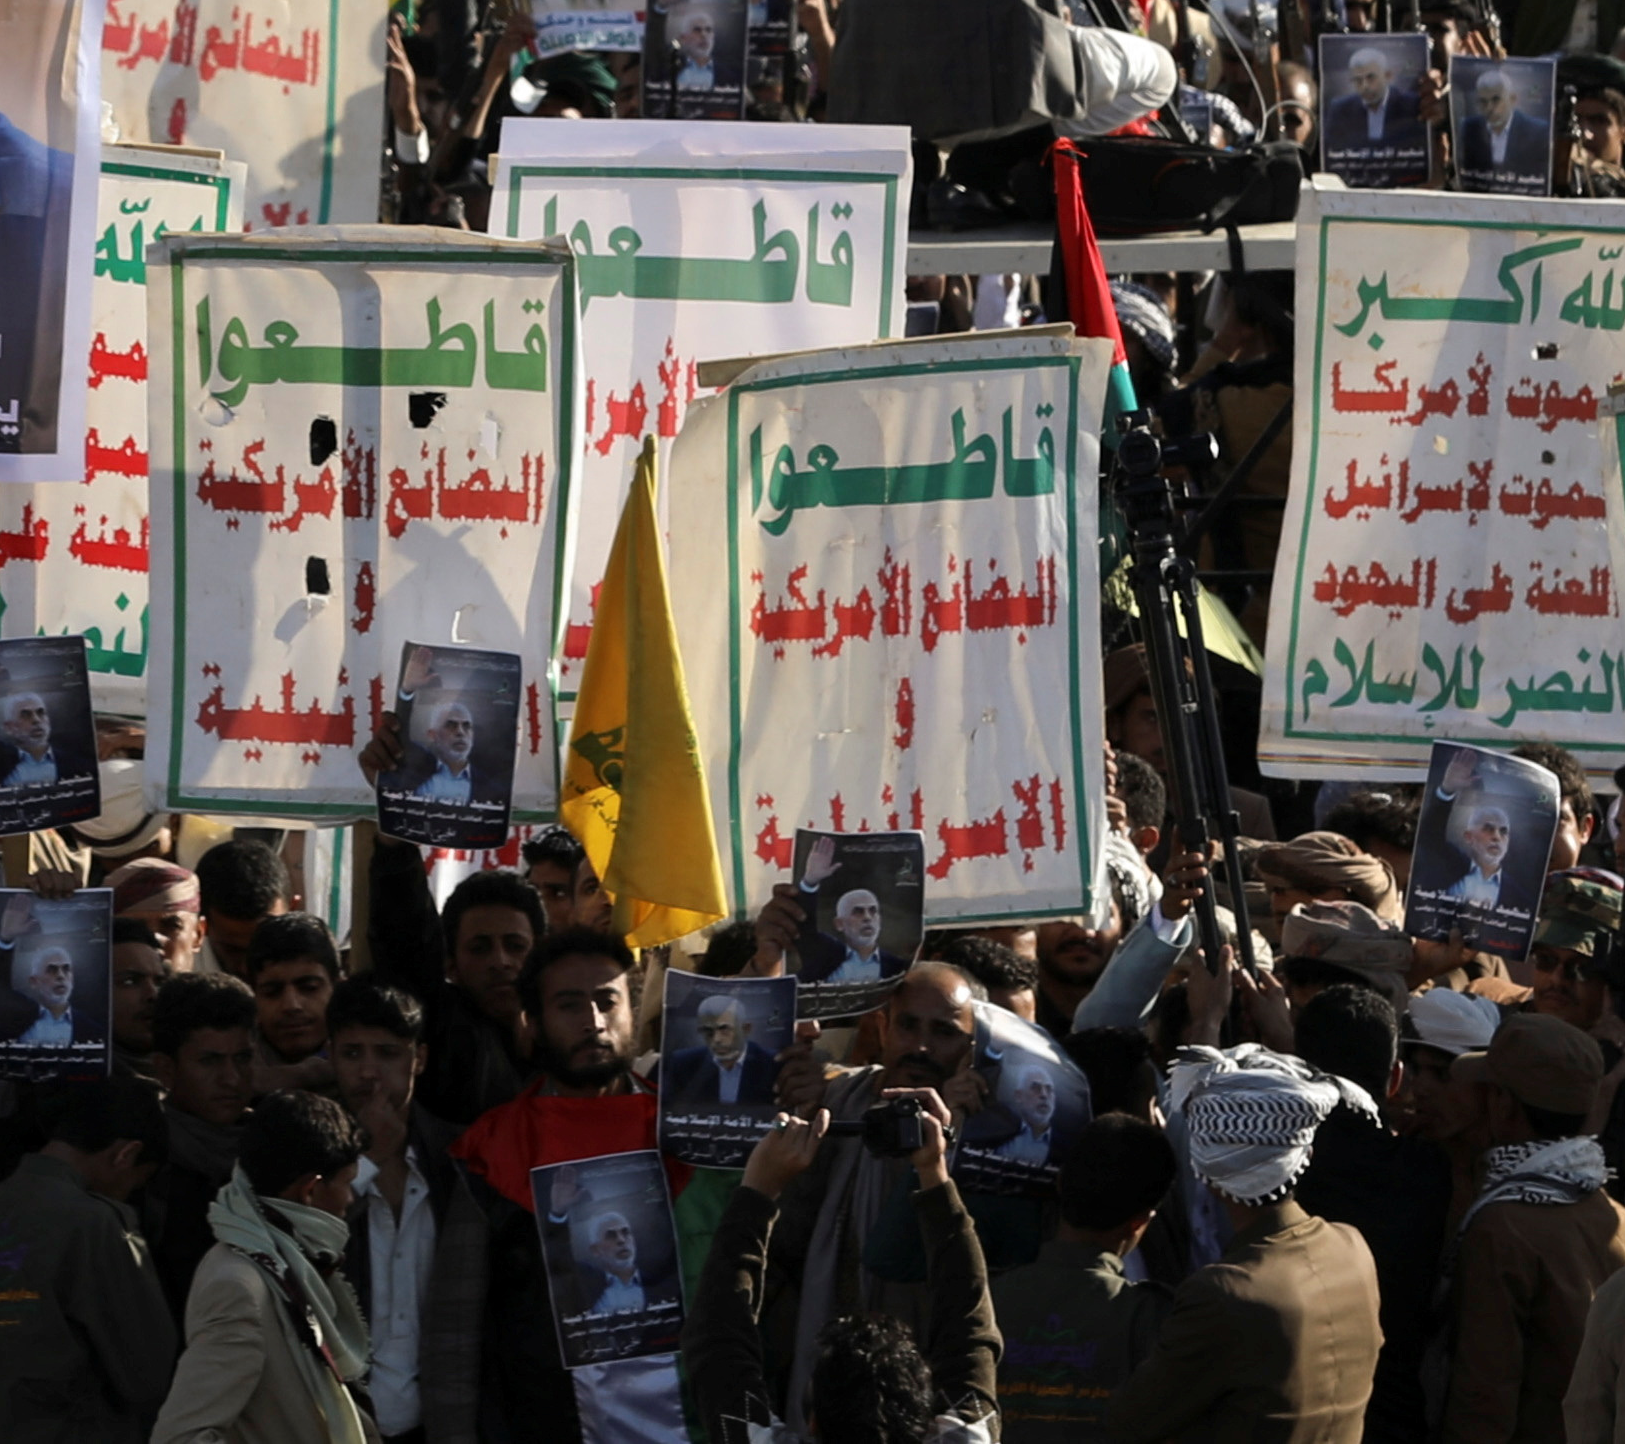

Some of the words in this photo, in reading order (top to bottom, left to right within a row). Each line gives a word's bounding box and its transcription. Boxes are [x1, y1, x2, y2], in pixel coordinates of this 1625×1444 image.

[199, 10, 320, 93] البضائع
[1336, 232, 1584, 342] أكبر
[197, 296, 550, 408] قاطعوا
[1332, 361, 1489, 425] لأمريكا
[196, 427, 376, 534] الأمريكية
[385, 449, 544, 538] البضائع
[751, 404, 1057, 536] قاطعوا
[1324, 455, 1492, 523] لإسرائيل
[353, 563, 377, 633] و
[749, 545, 914, 659] الأمريكية
[921, 555, 1056, 652] البضائع
[1312, 558, 1436, 620] اليهود
[1445, 564, 1515, 624] على
[893, 677, 915, 749] و
[1300, 644, 1484, 739] للإسلام
